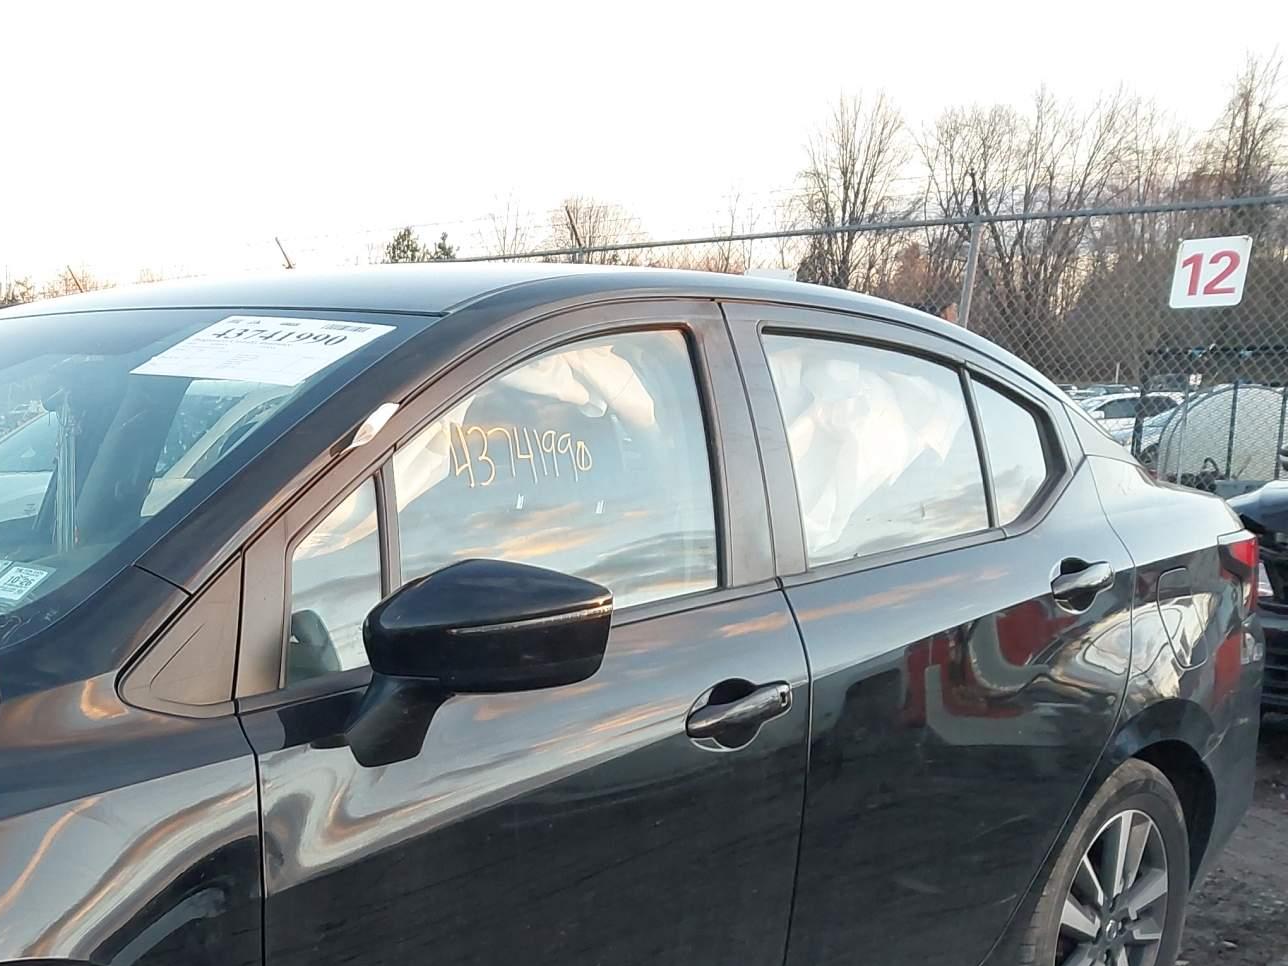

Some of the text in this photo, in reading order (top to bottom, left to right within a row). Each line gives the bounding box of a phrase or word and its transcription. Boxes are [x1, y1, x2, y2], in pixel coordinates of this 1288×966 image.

[1181, 249, 1241, 297] 12
[212, 327, 348, 346] 43741990
[449, 423, 593, 488] 43741990
